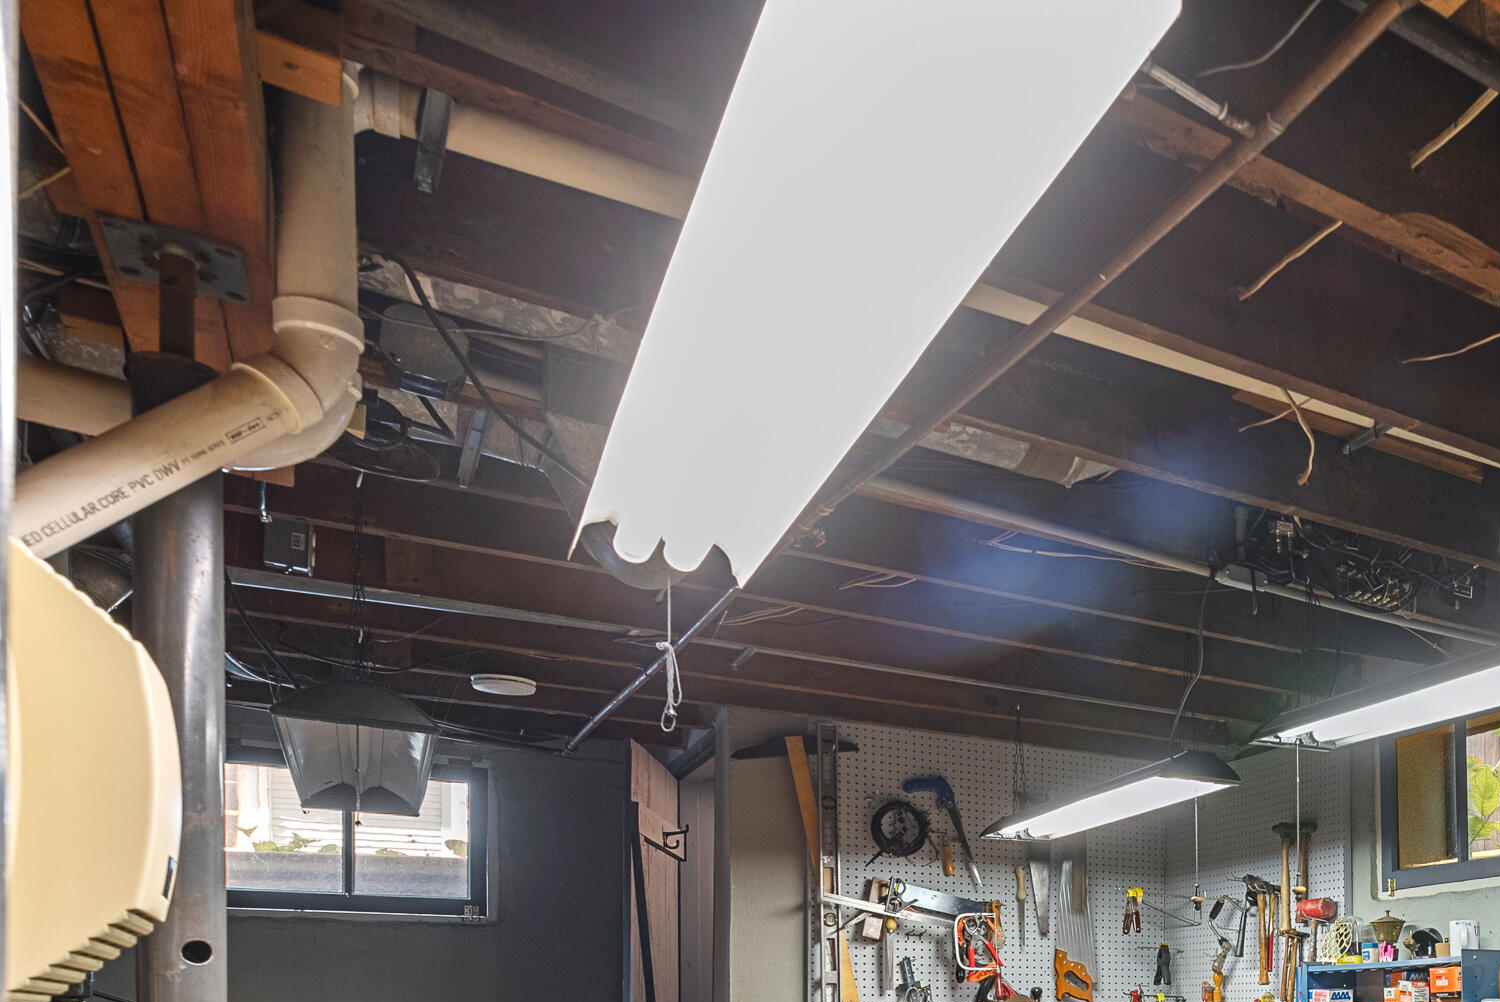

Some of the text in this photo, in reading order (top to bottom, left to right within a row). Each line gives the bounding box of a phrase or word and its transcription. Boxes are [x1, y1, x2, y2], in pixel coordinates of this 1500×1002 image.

[41, 501, 100, 538] CELLULAR
[98, 485, 130, 510] CORE
[129, 475, 154, 496] PVC
[153, 460, 181, 483] DWV
